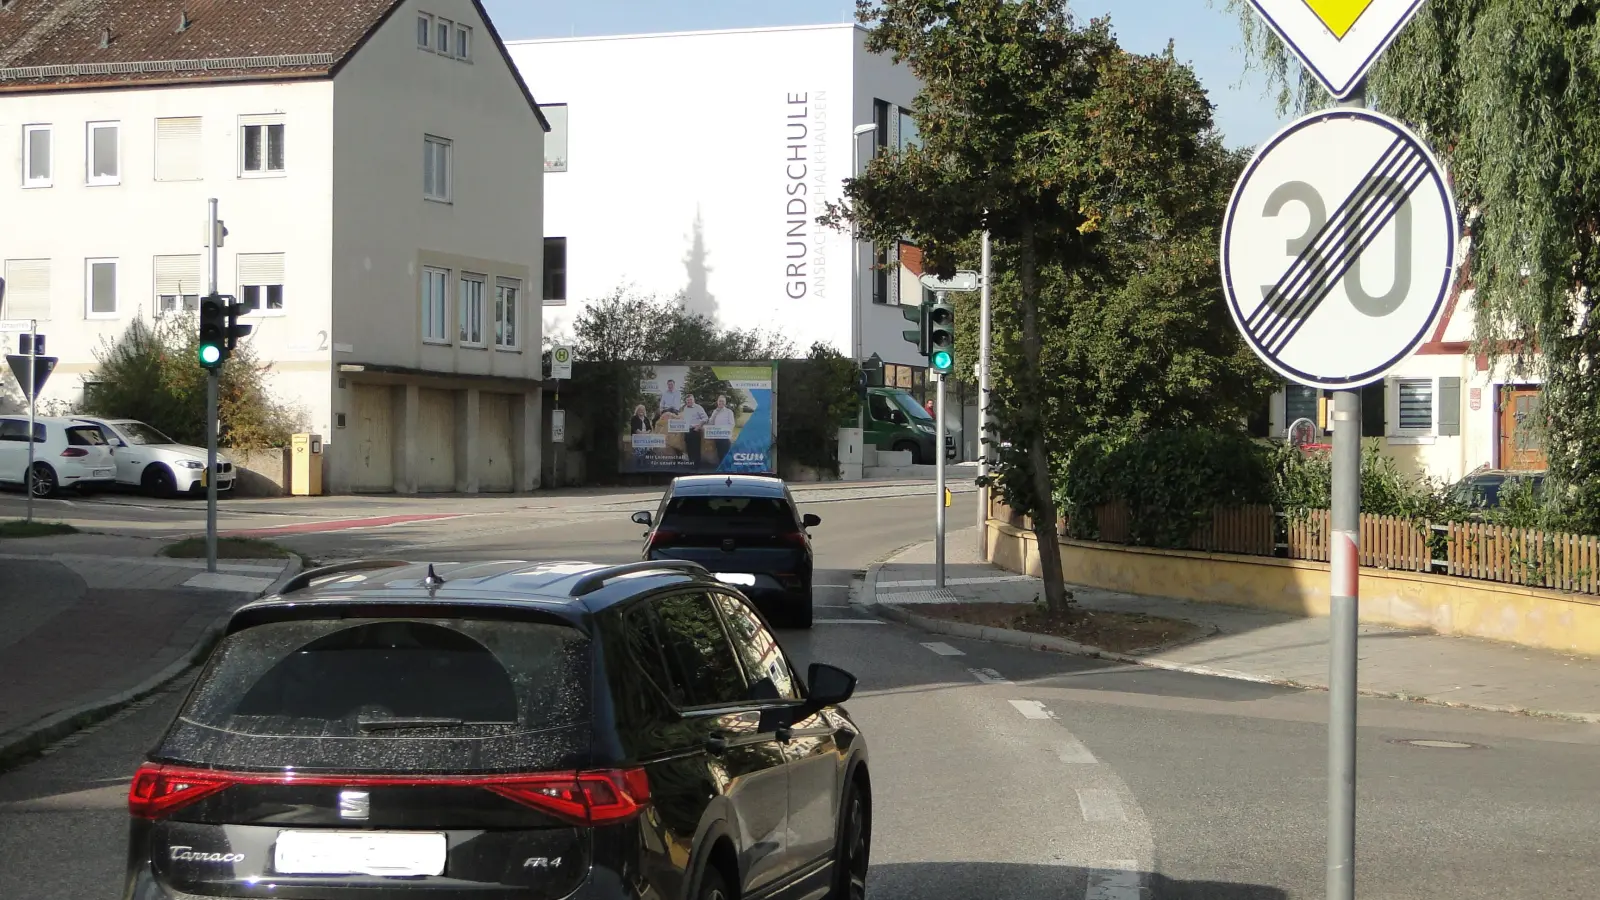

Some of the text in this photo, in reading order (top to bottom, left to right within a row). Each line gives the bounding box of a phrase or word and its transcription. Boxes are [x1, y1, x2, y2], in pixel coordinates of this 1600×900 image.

[786, 92, 808, 300] GRUNDSCHULE
[813, 91, 827, 299] ANSBACH SCHALKHAUSEN
[1260, 175, 1413, 319] 30
[317, 330, 328, 351] 2
[733, 452, 754, 461] CSU
[169, 845, 245, 862] Tarraco
